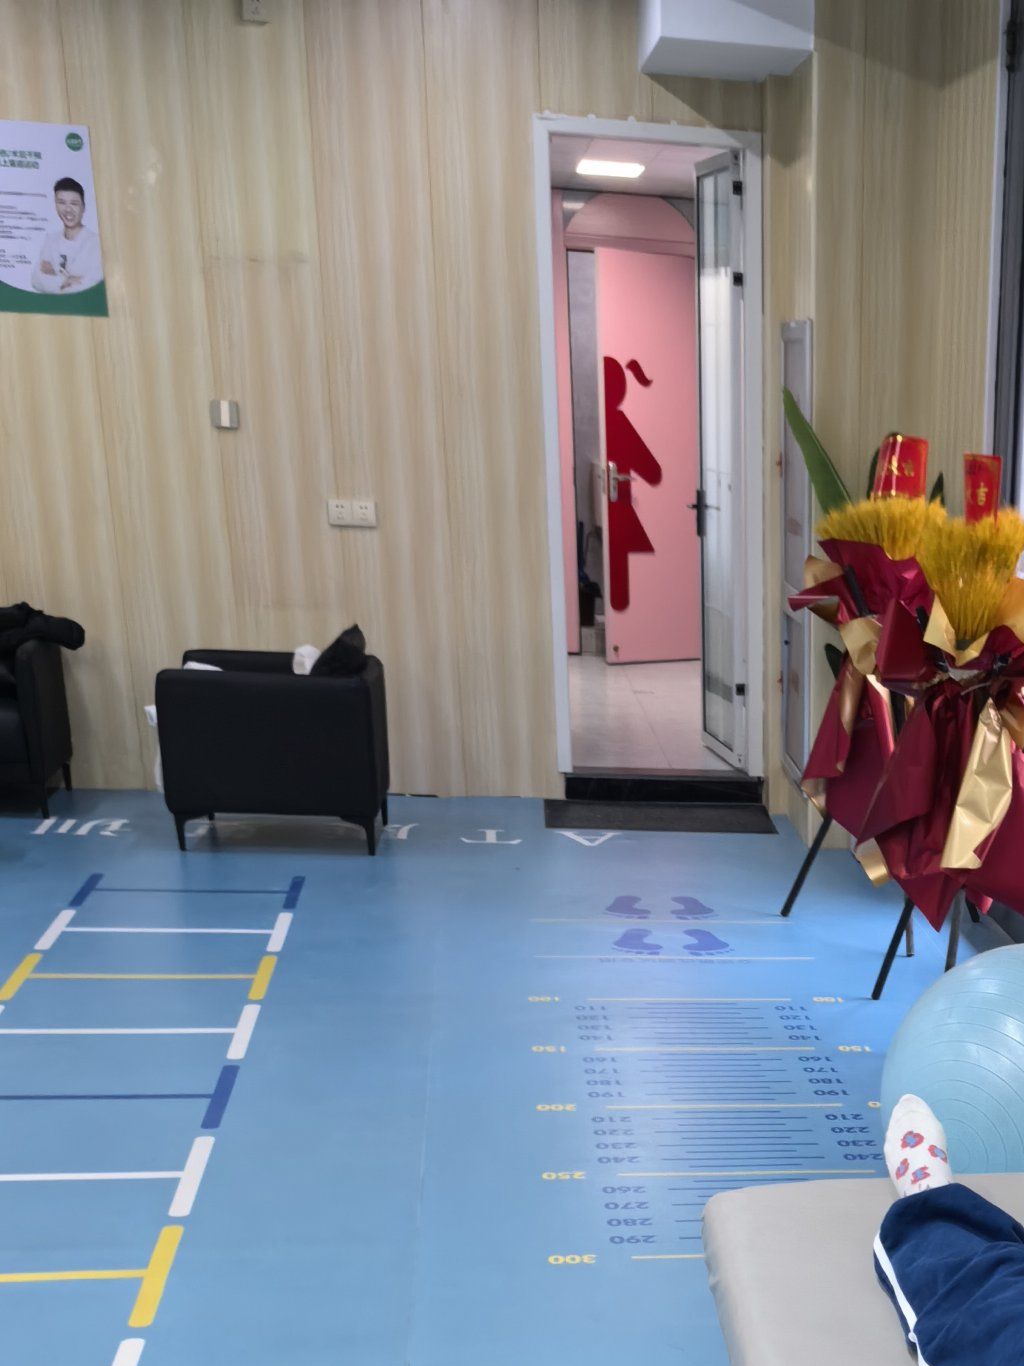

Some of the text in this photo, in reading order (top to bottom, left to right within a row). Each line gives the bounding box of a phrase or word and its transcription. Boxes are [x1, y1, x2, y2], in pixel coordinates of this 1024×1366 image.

[536, 1103, 577, 1112] 200
[596, 1142, 637, 1150] 230
[597, 1156, 641, 1164] 240
[843, 1153, 883, 1161] 240
[541, 1171, 587, 1180] 250
[602, 1186, 647, 1194] 260
[604, 1201, 650, 1210] 270
[606, 1217, 653, 1227] 280
[608, 1234, 657, 1245] 290
[547, 1254, 598, 1265] 300
